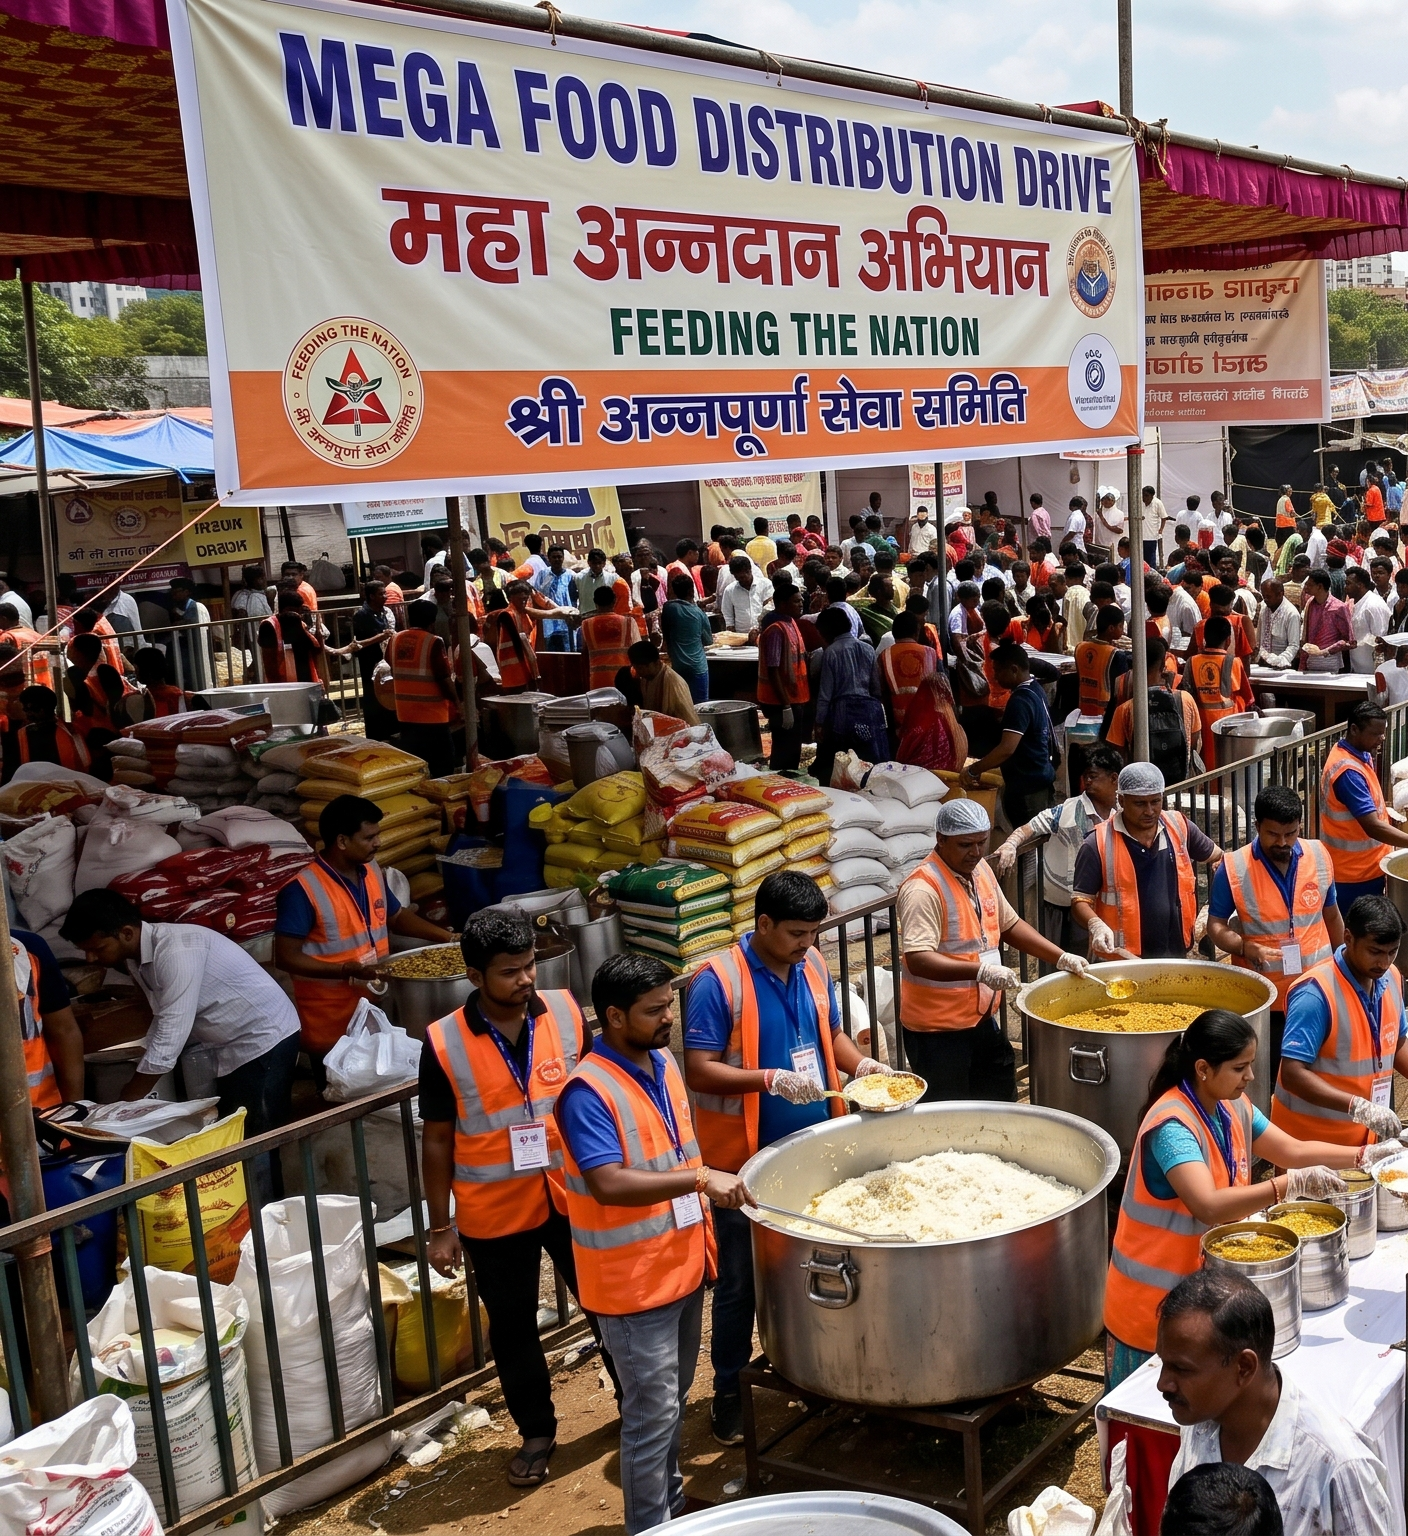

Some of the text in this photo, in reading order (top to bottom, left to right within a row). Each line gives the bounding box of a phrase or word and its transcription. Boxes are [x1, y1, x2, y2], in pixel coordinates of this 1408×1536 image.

[279, 32, 1112, 215] MEGA FOOD DISTRIBUTION DRIVE
[382, 188, 549, 285] महा
[574, 205, 840, 288] अन्नदान
[859, 204, 1050, 297] अभियान
[292, 325, 412, 380] FEEDING THE NATION
[612, 309, 980, 356] FEEDING THE NATION
[508, 370, 1028, 458] श्री अन्नपूर्णा सेवा समिति
